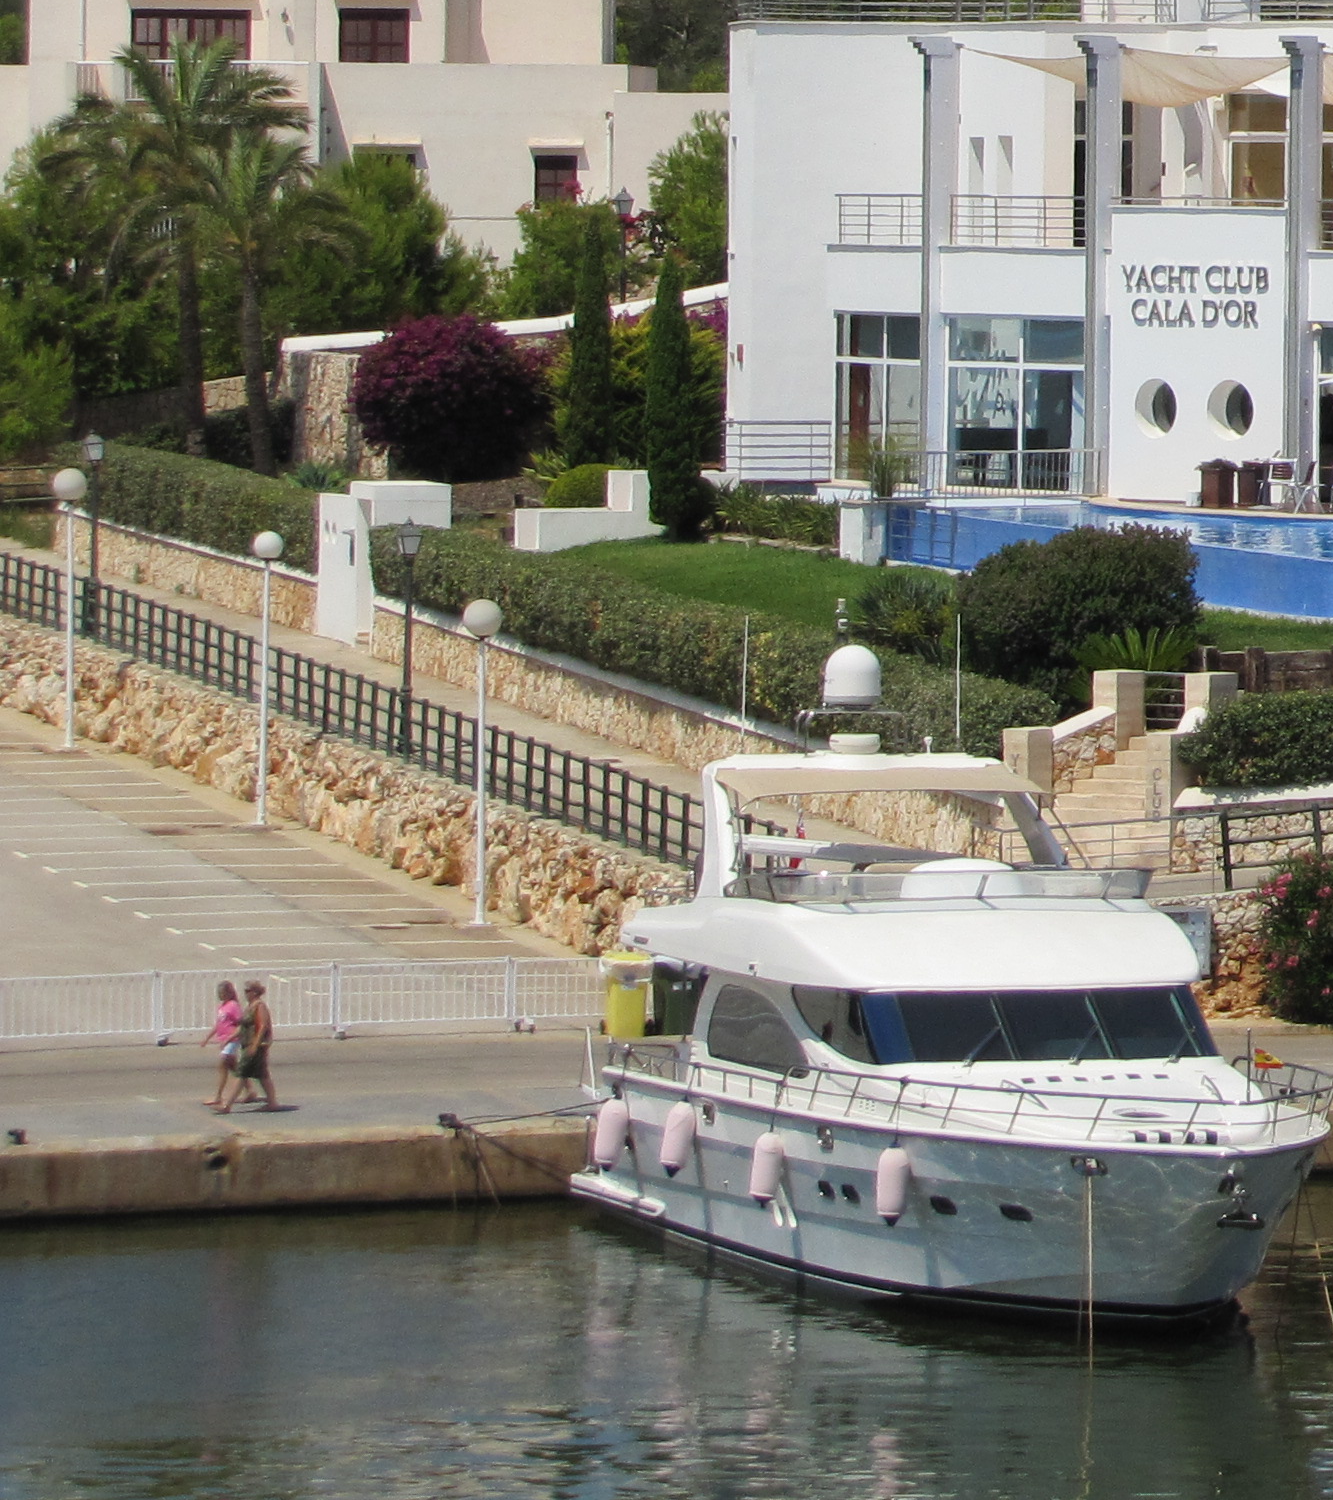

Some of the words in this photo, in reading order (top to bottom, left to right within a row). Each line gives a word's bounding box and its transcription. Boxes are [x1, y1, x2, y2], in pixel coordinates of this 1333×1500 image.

[1121, 264, 1200, 292] YACHT
[1205, 264, 1271, 293] CLUB
[1131, 298, 1195, 328] CALA
[1201, 299, 1259, 329] D'OR
